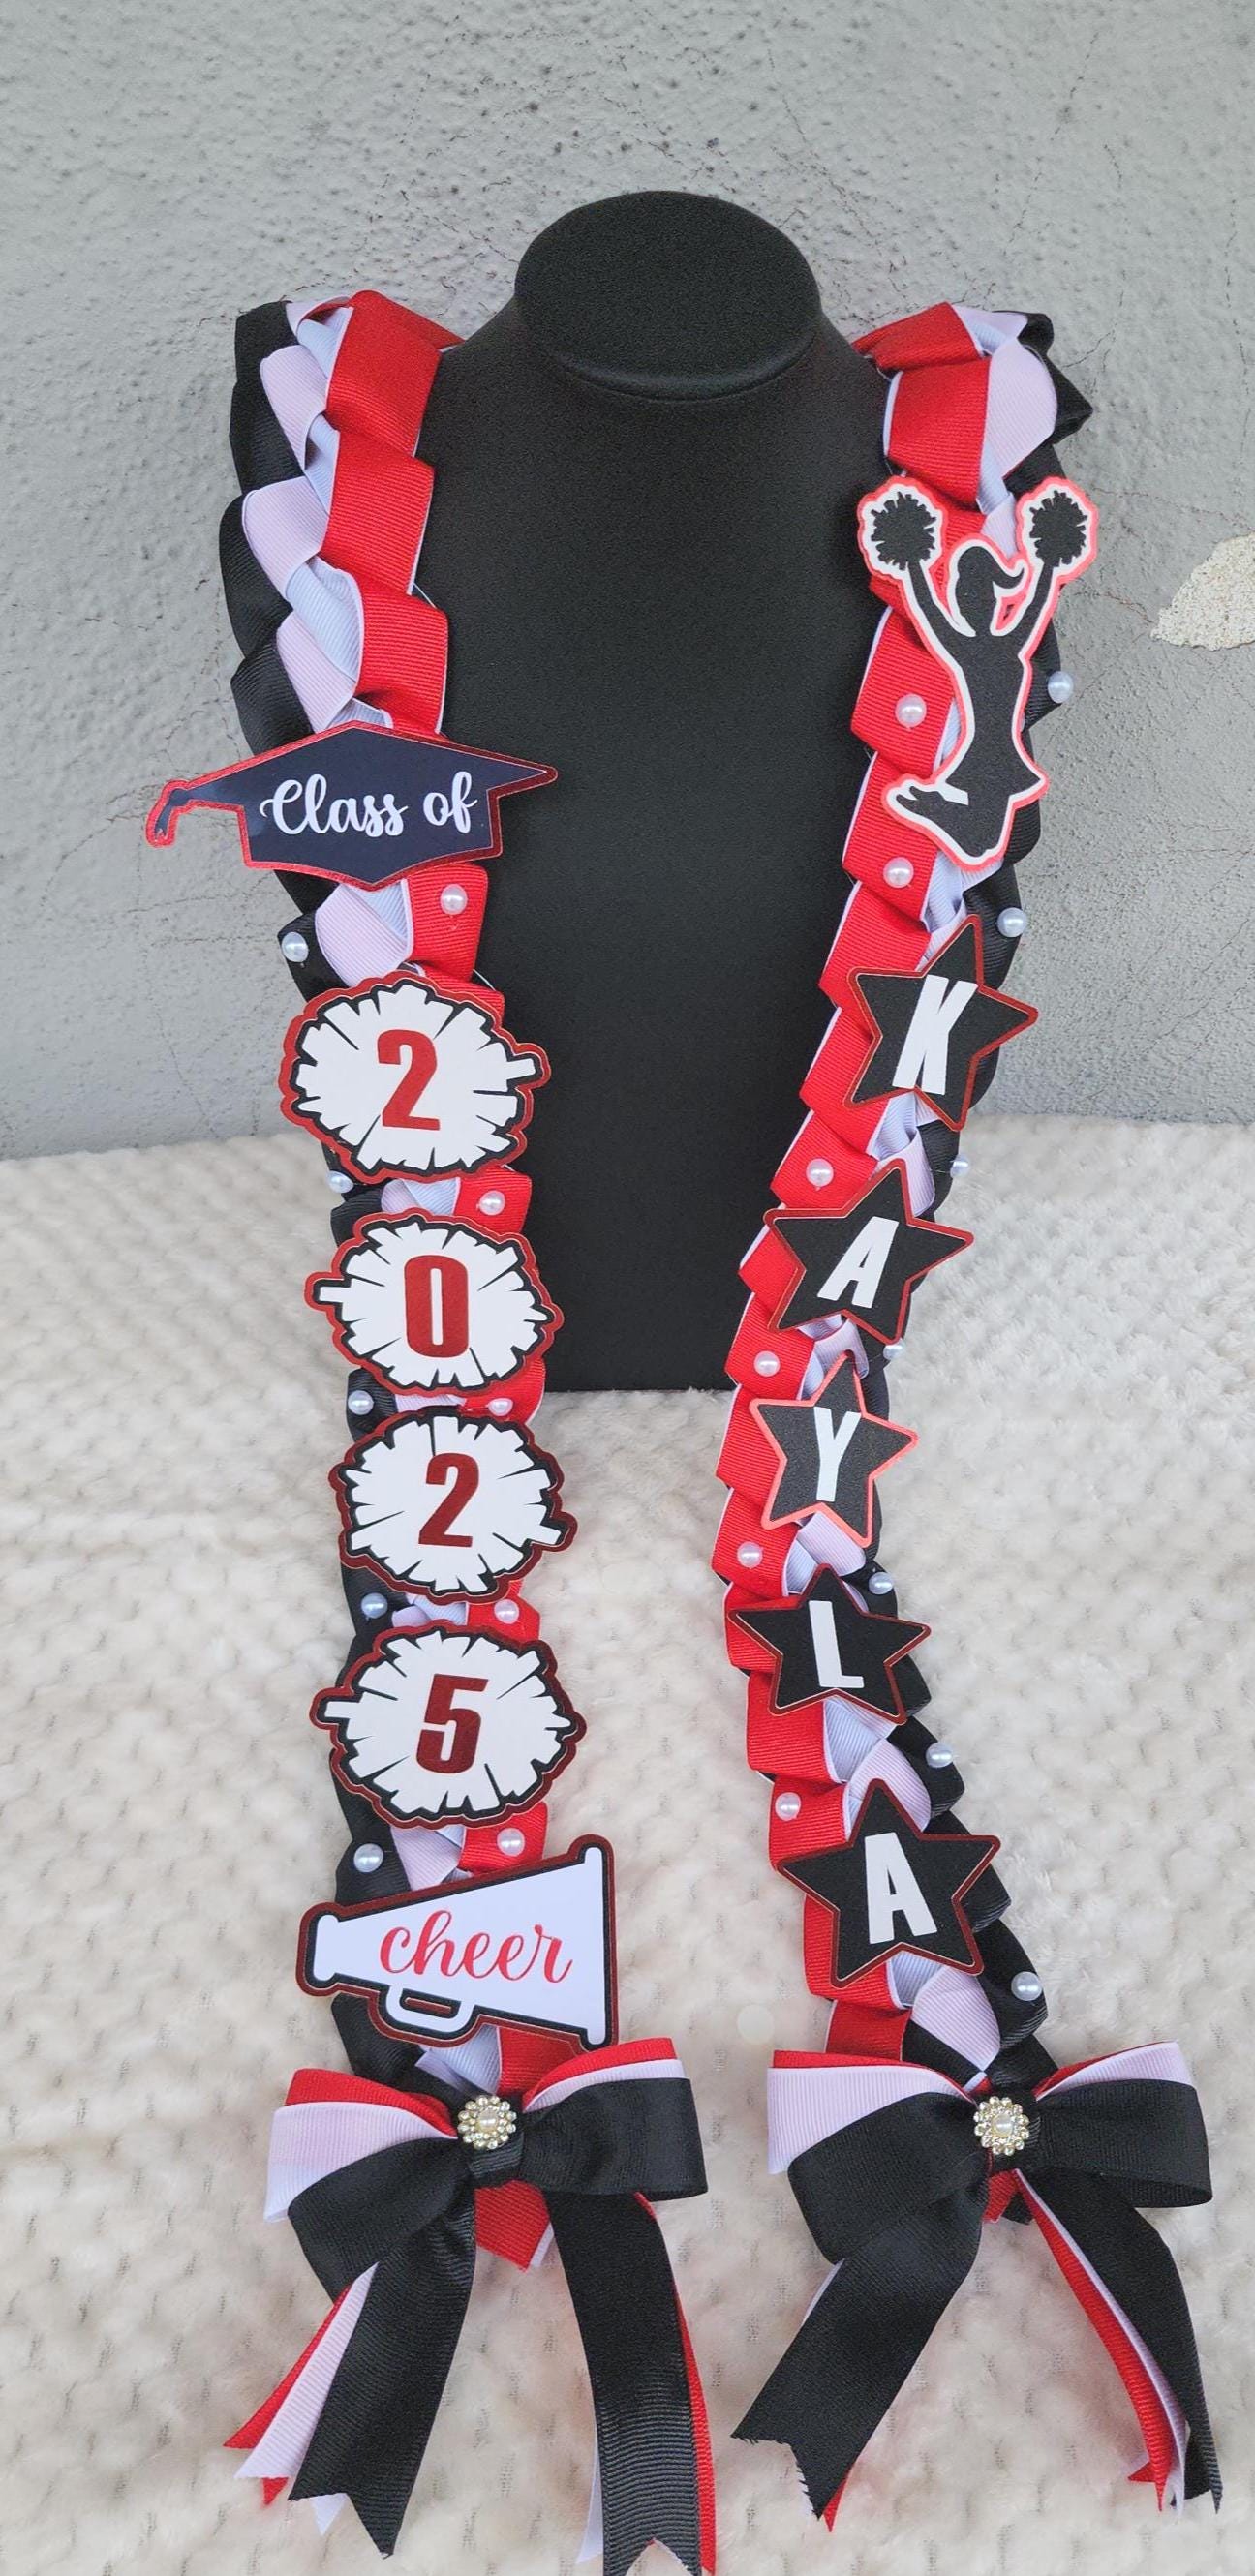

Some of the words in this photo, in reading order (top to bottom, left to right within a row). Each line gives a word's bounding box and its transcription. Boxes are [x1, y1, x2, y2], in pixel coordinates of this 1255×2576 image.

[260, 773, 408, 838] Class
[422, 771, 477, 833] of
[379, 1910, 573, 1984] cheer
